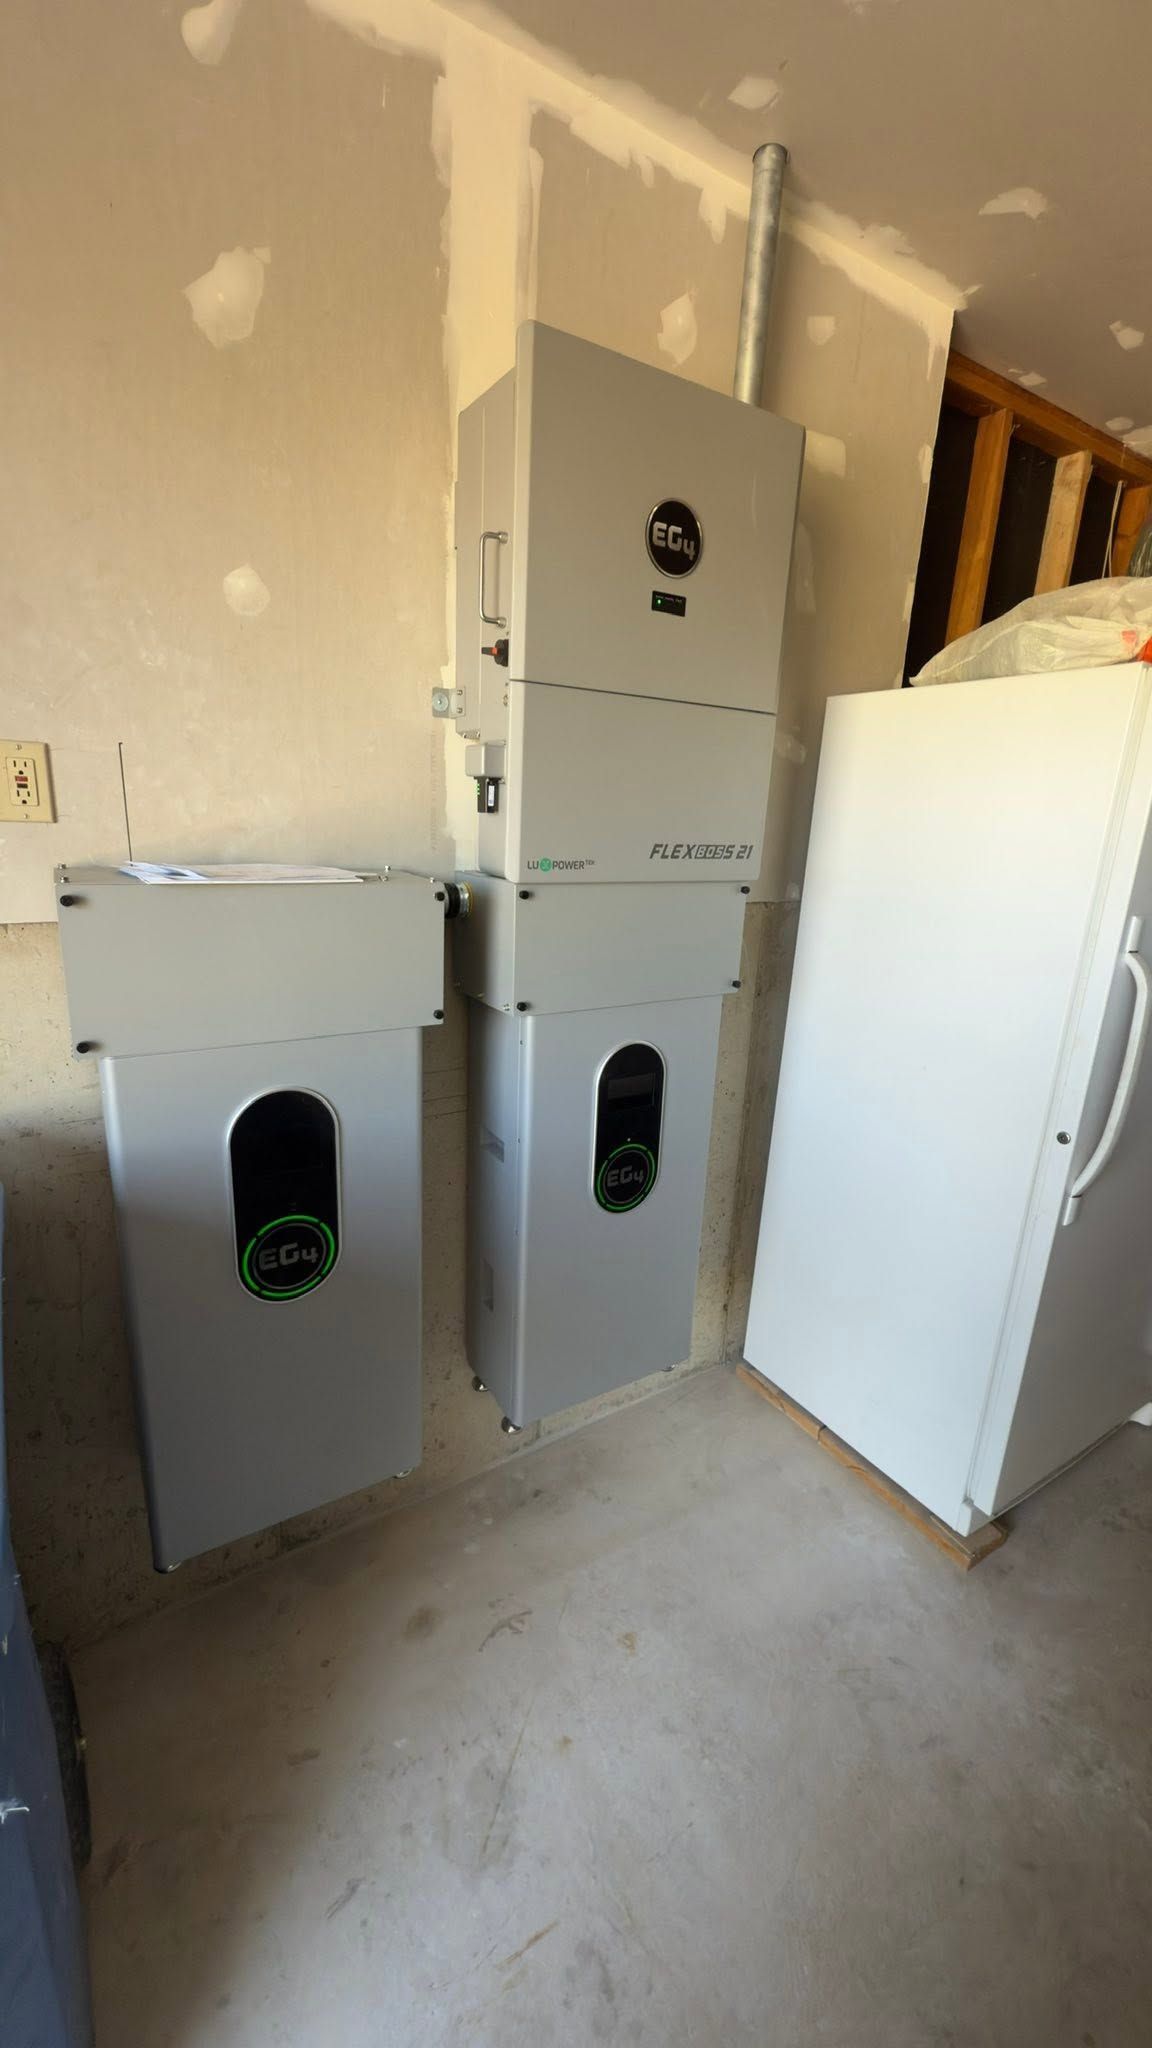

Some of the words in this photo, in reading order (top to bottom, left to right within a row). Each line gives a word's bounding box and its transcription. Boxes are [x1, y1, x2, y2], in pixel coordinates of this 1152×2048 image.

[652, 521, 696, 561] EG4
[735, 844, 754, 860] 21
[606, 1165, 644, 1188] EG4
[258, 1242, 320, 1271] EG4
